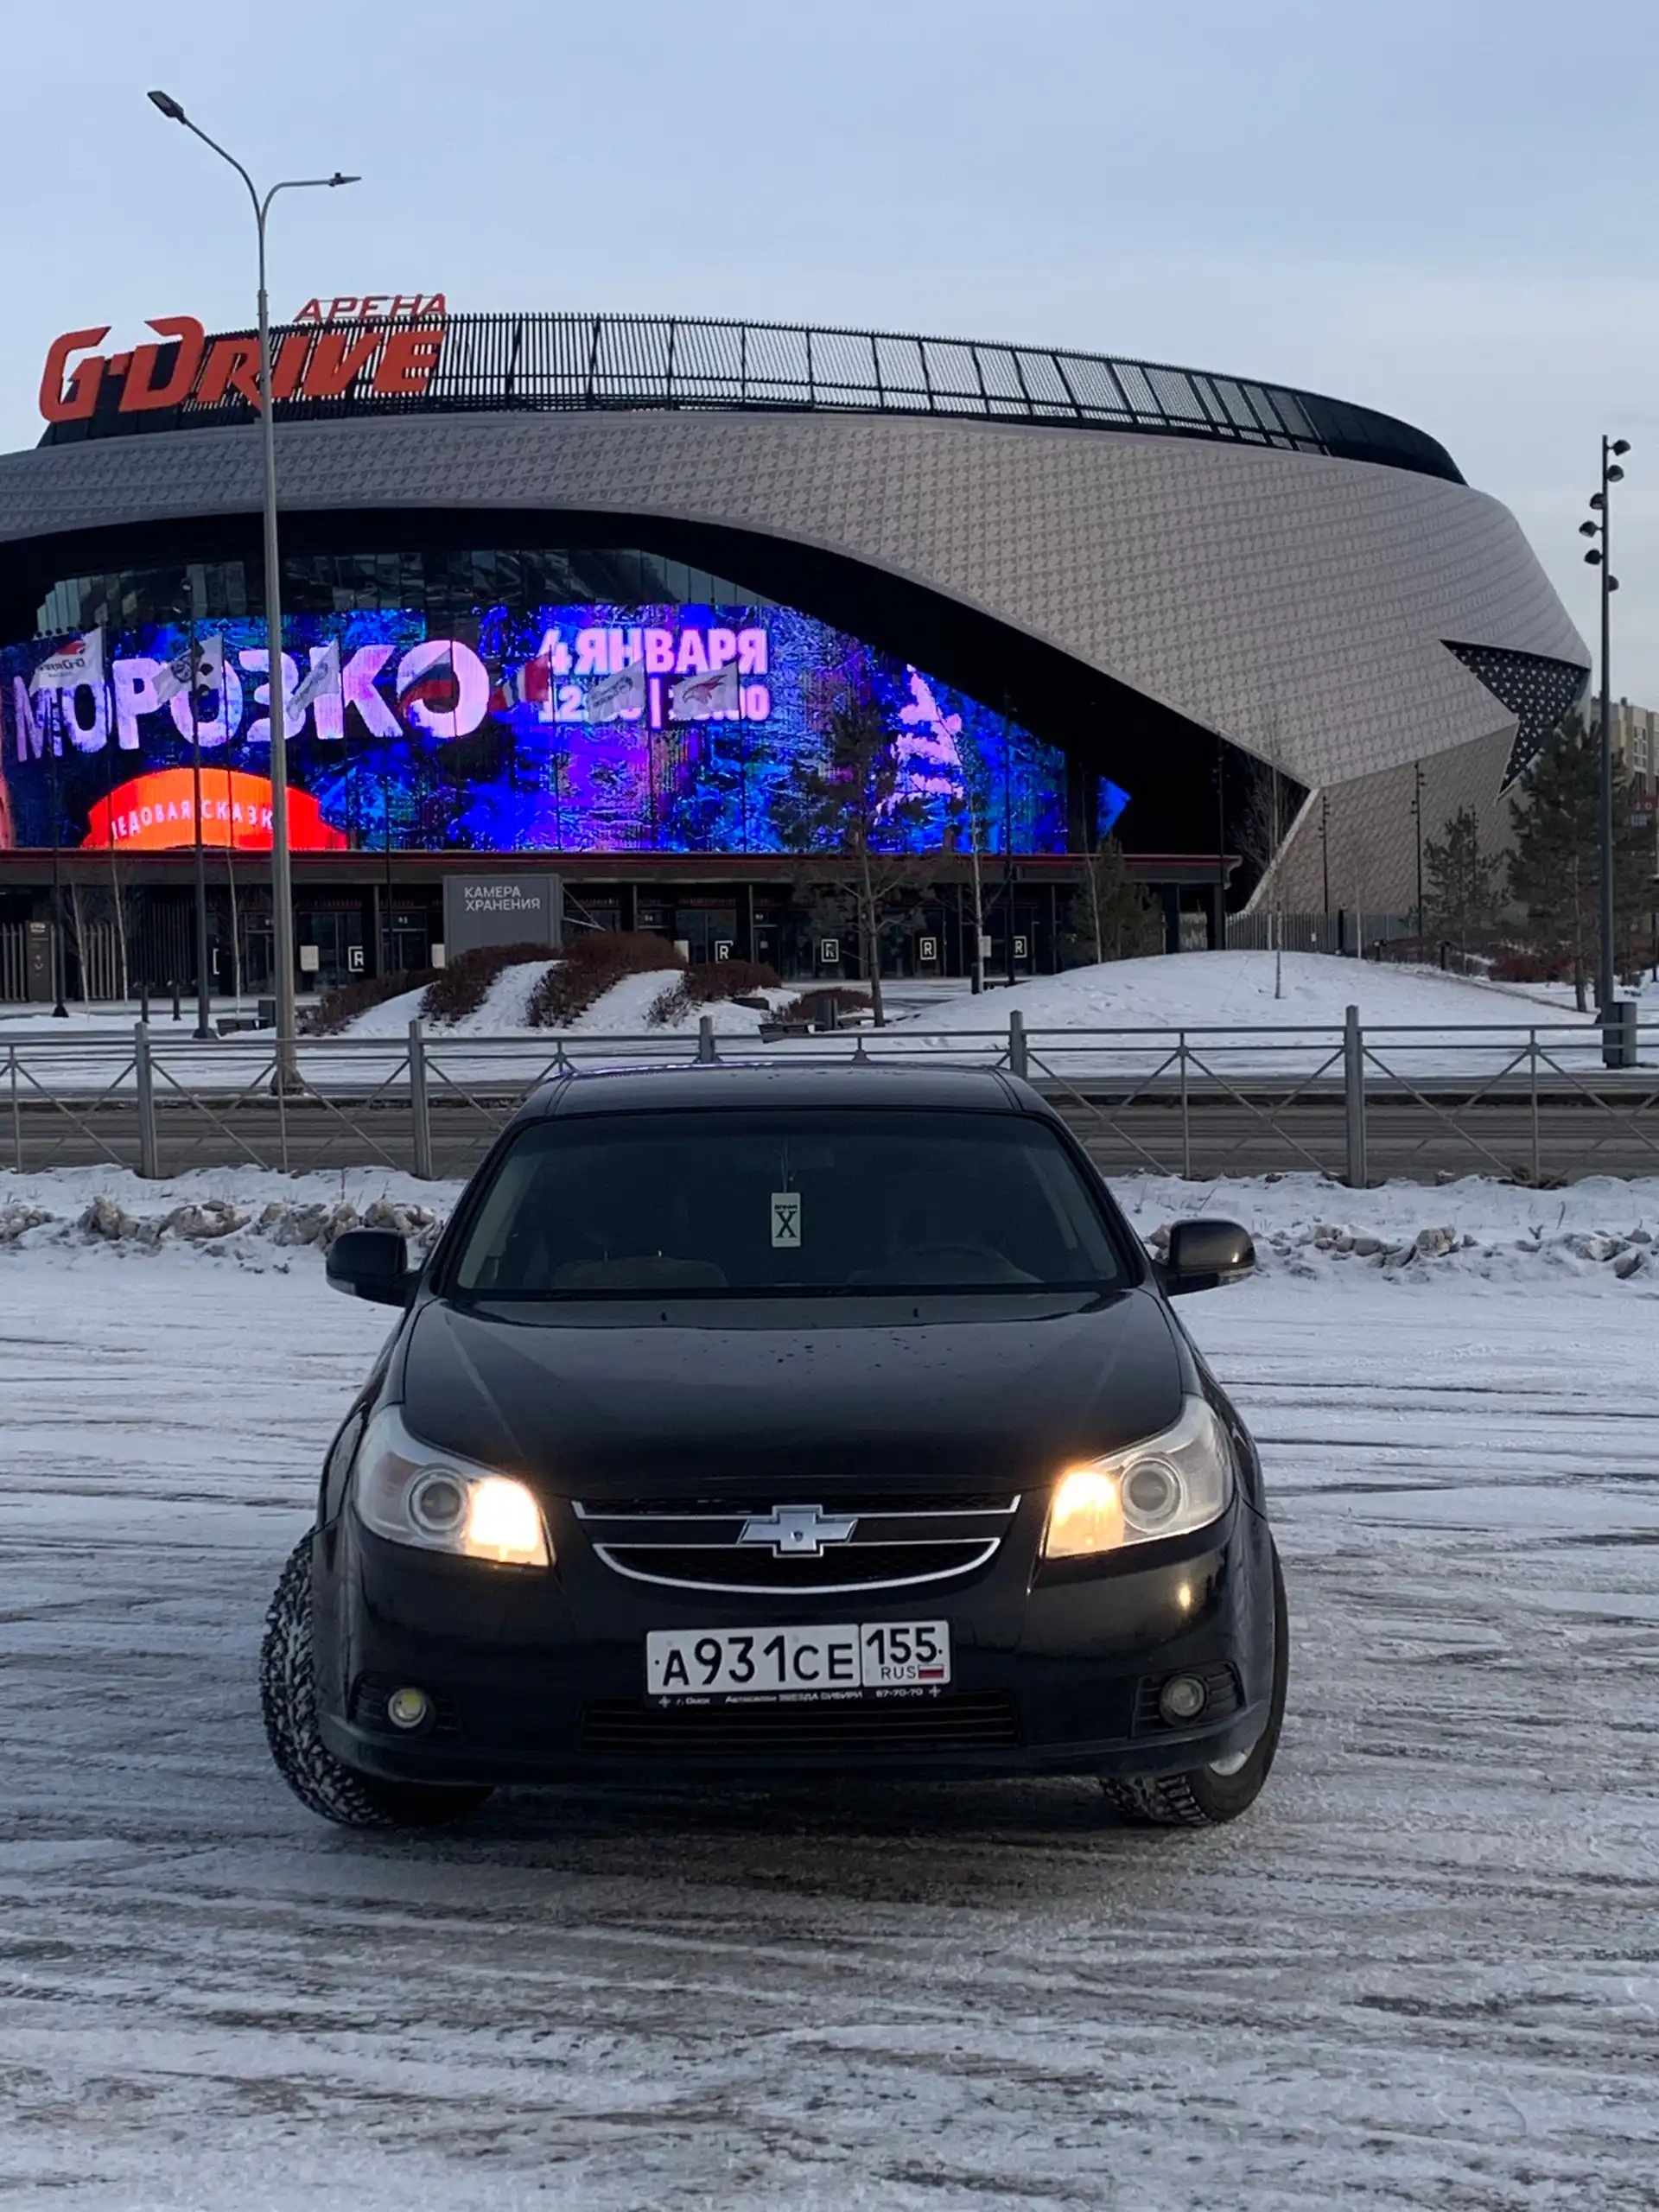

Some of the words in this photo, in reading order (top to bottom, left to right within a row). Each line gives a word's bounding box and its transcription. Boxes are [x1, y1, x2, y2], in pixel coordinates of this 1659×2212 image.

[294, 293, 447, 322] АРЕНА
[537, 628, 572, 675] 4
[575, 628, 768, 675] ЯНВАРЯ
[14, 639, 489, 762] МОРОЗКО
[201, 799, 273, 830] СКАЗК
[464, 886, 521, 898] КАМЕРА
[465, 898, 541, 912] ХРАНЕНИЯ
[774, 1211, 798, 1238] X
[867, 1627, 938, 1664] 155
[881, 1666, 916, 1680] RUS
